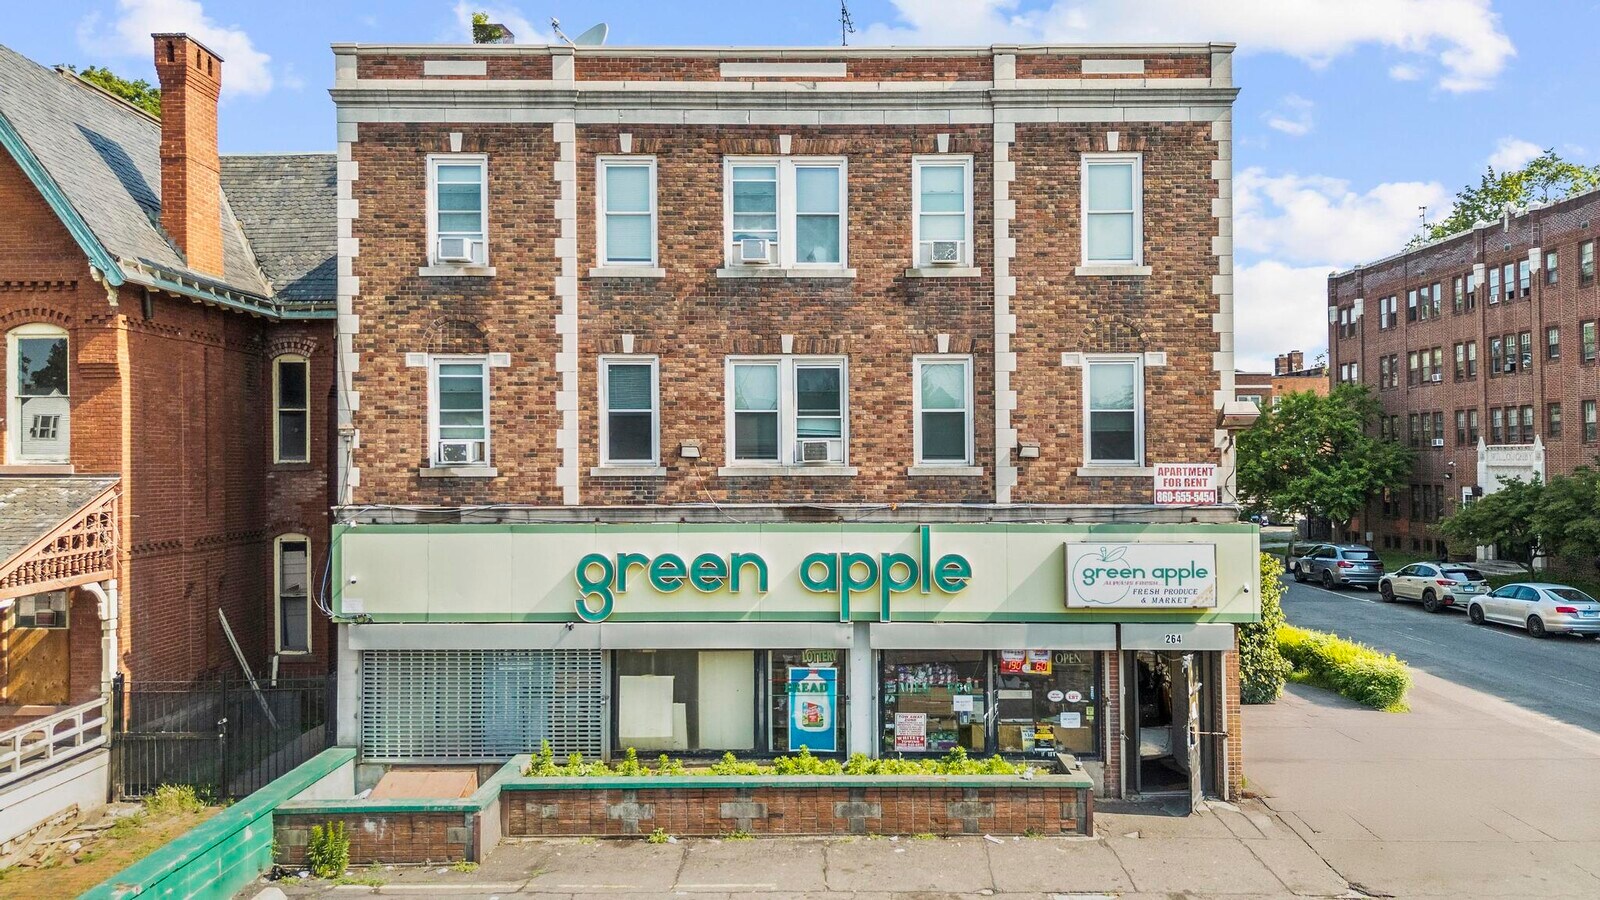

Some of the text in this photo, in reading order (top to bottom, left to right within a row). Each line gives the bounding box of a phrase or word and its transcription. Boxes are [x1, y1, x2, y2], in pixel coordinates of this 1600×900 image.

[1157, 467, 1214, 476] APARTMENT
[1163, 478, 1208, 487] FOR RENT
[1156, 490, 1215, 503] 860-655-5454
[574, 524, 972, 623] green apple
[1082, 560, 1209, 586] green apple
[1132, 588, 1199, 596] FRESH PRODUCE
[1165, 634, 1182, 644] 264
[801, 649, 839, 663] LOTTERY
[1055, 653, 1082, 664] OPEN
[1035, 662, 1047, 671] 60
[784, 682, 829, 693] BREAD
